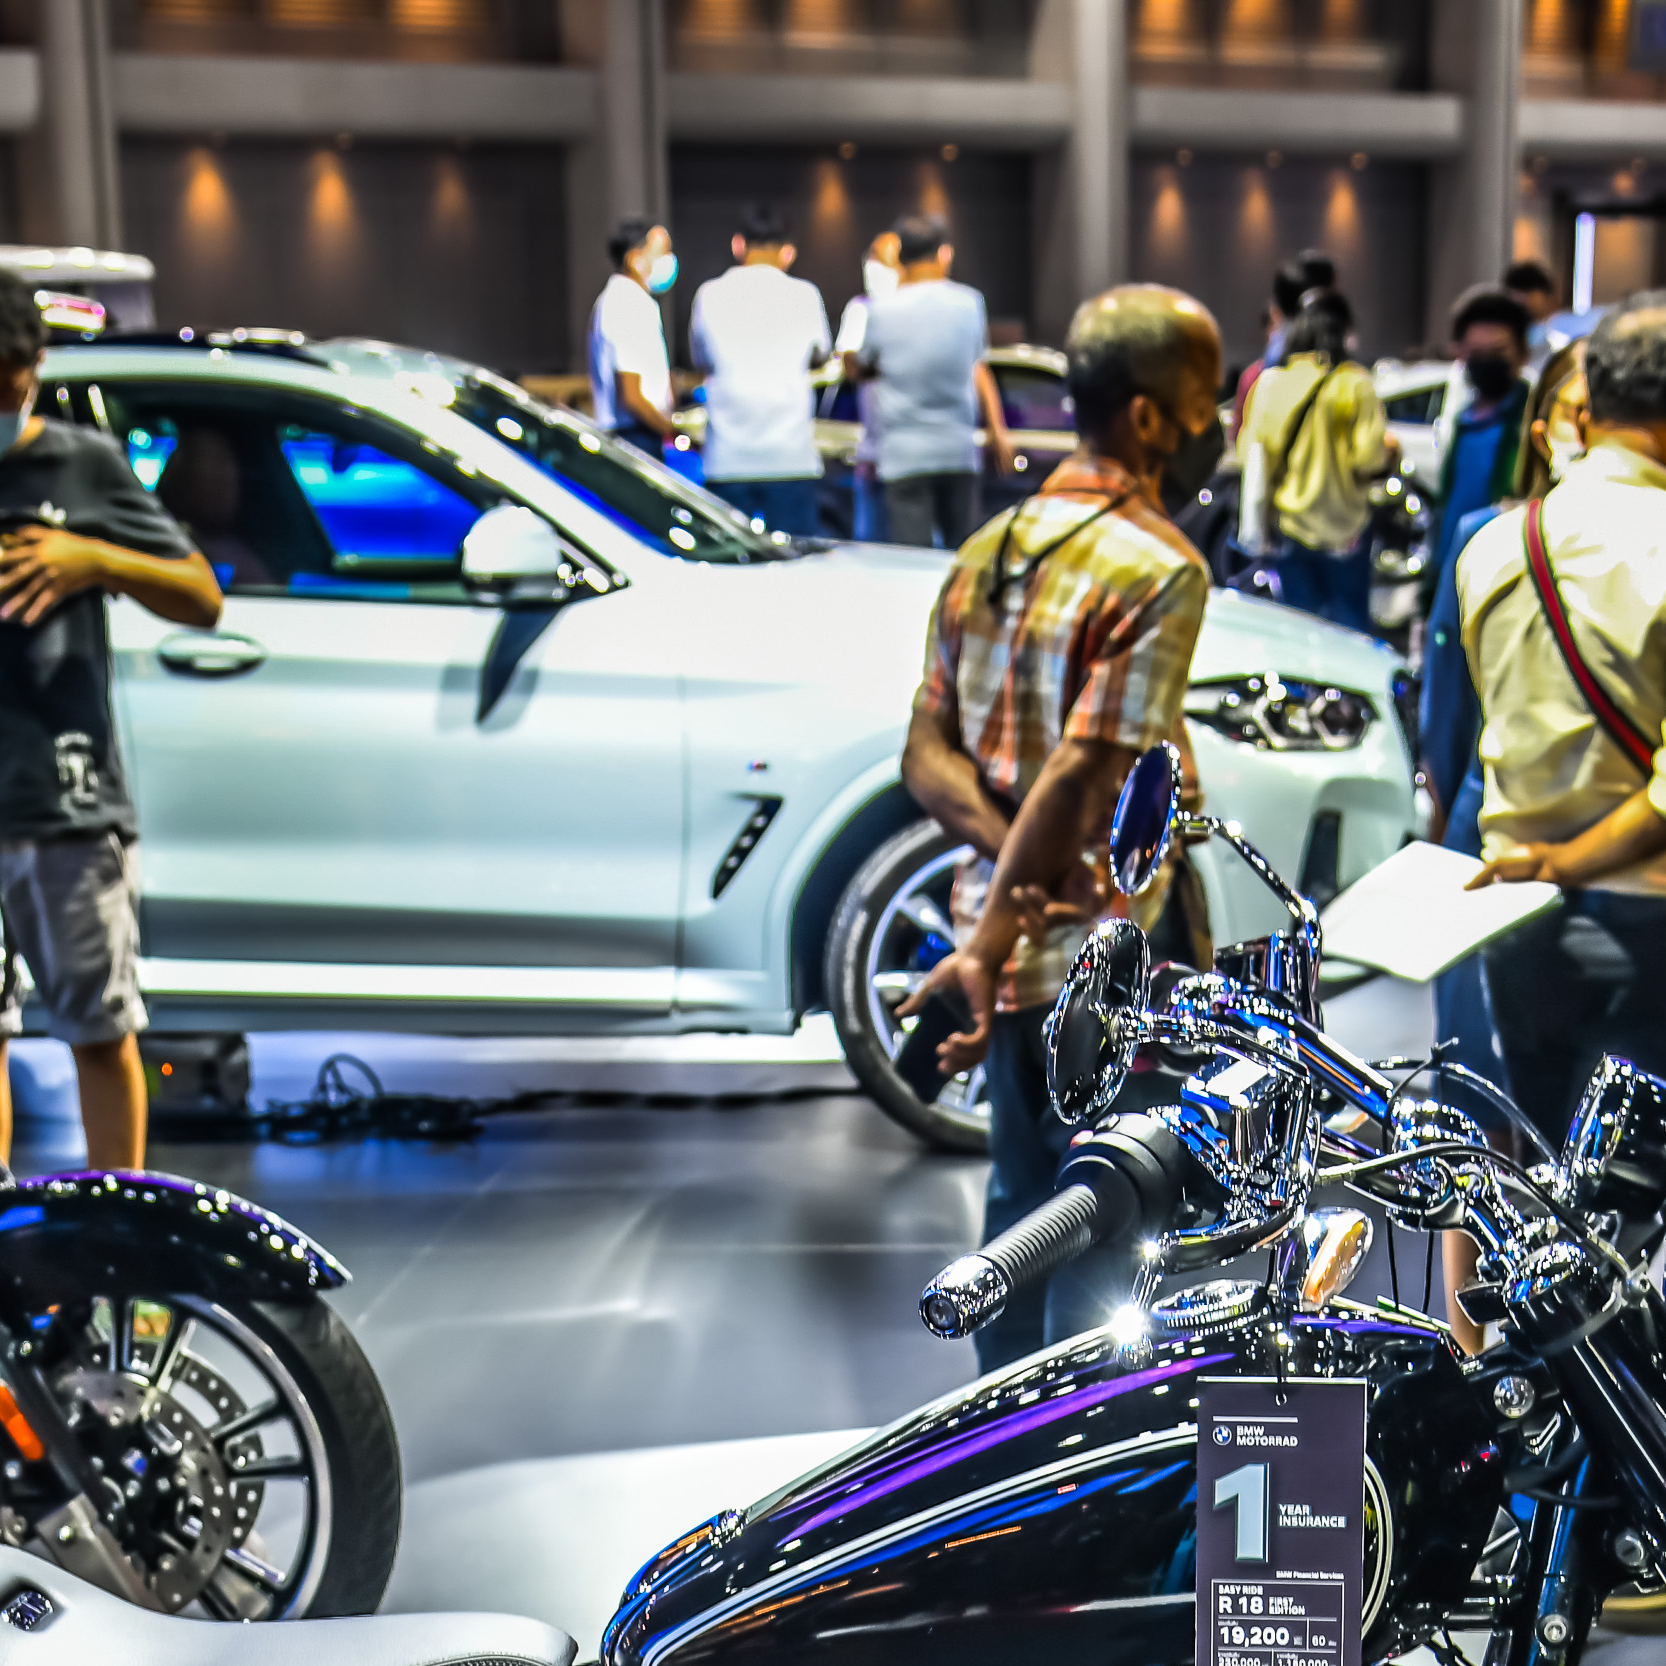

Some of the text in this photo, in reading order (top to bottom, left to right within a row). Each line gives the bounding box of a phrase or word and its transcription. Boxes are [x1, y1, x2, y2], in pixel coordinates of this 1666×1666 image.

[1236, 1425, 1265, 1436] BMW
[1236, 1435, 1298, 1447] MOTORRAD
[1213, 1462, 1270, 1563] 1
[1278, 1504, 1312, 1516] YEAR
[1278, 1515, 1346, 1529] INSURANCE
[1242, 1585, 1264, 1596] RIDE
[1218, 1596, 1264, 1615] R 18
[1220, 1626, 1290, 1647] 19,200
[1311, 1635, 1326, 1647] 60
